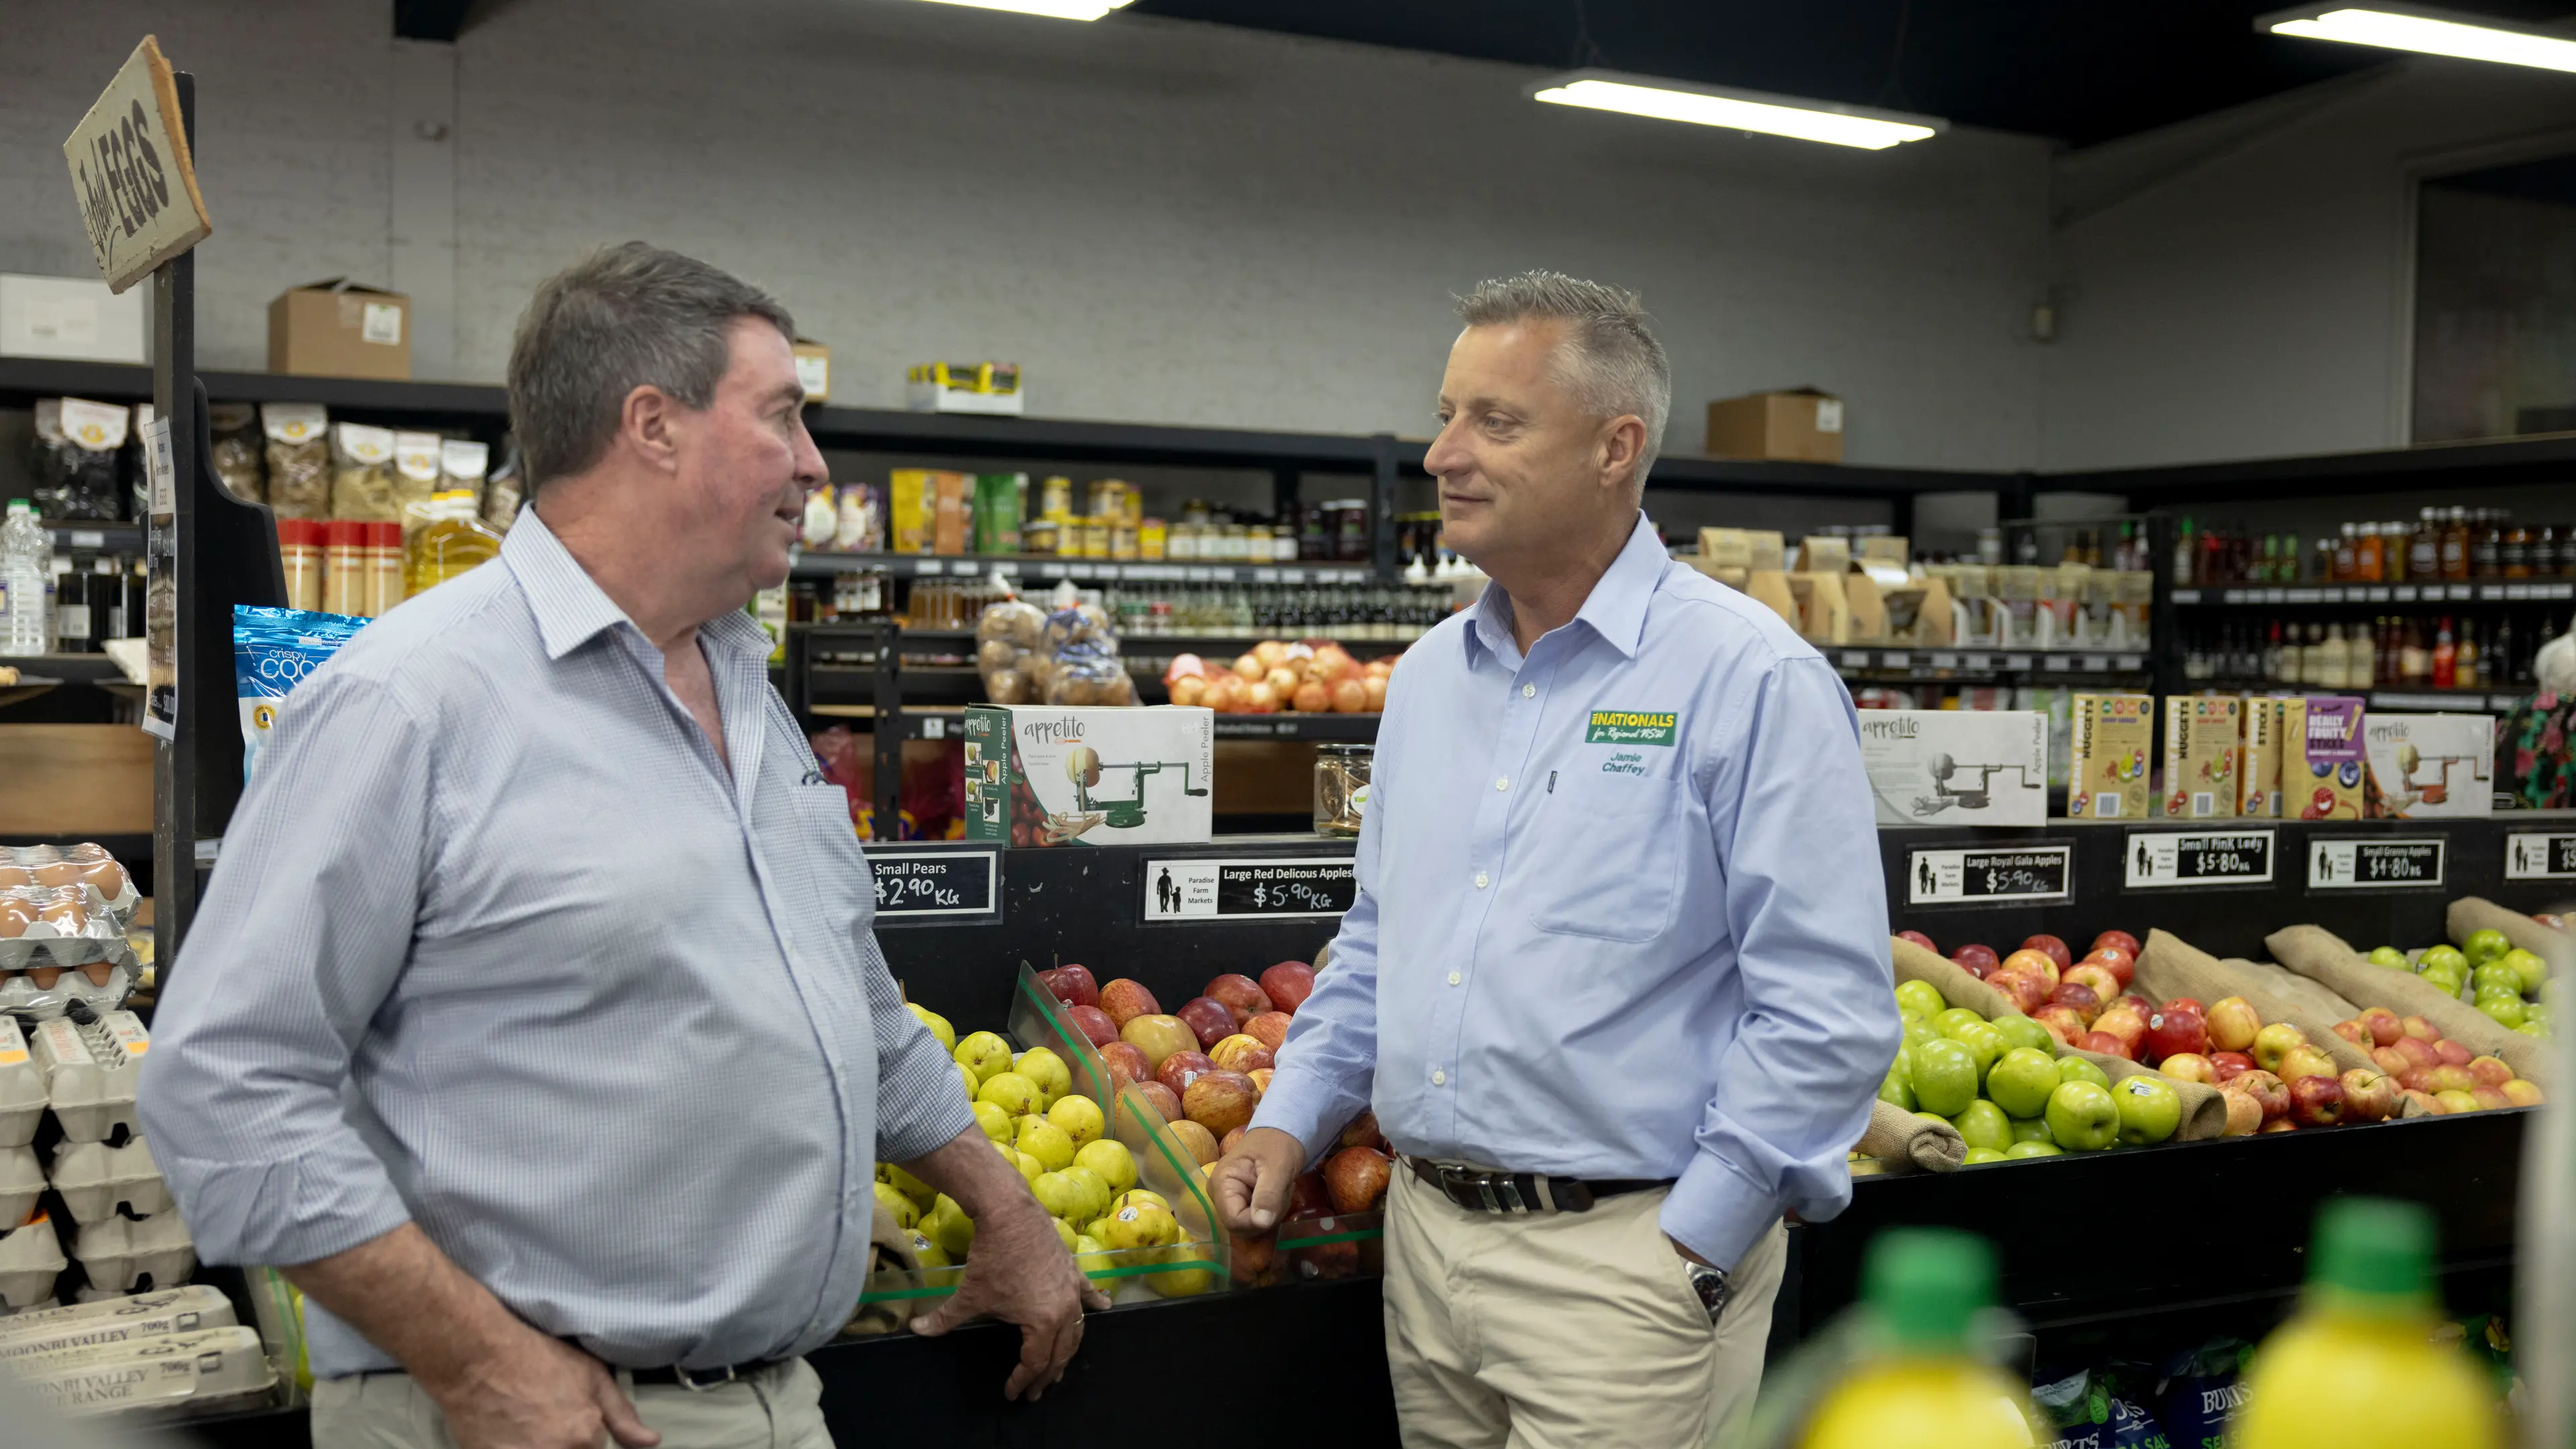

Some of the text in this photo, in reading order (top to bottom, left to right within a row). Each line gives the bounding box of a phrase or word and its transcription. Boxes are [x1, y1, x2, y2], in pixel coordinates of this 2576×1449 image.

[97, 99, 169, 238] EGGS
[269, 649, 307, 661] crispy
[260, 658, 327, 679] COC
[965, 714, 991, 736] appetito
[1597, 713, 1674, 727] NATIONALS
[1863, 716, 1919, 739] appetito
[1024, 716, 1085, 744] appetito
[1608, 727, 1640, 741] Regional
[1640, 728, 1666, 739] NSW
[2083, 700, 2094, 759] NUGGETS
[2179, 701, 2190, 759] NUGGETS
[1201, 716, 1210, 782] Apple Peeler
[1611, 752, 1642, 762] Jamie
[1602, 763, 1646, 776] Chaffey
[2180, 838, 2208, 851] Small
[2237, 836, 2263, 853] Lady
[875, 863, 947, 875] Small Pears
[1967, 854, 2061, 869] Large Royal Gala Apples
[1189, 877, 1214, 885] Paradise
[1224, 867, 1352, 881] Large Red Delicous Apples
[70, 1329, 131, 1346] VALLEY
[83, 1368, 149, 1389] VALLEY
[72, 1384, 133, 1405] RANGE
